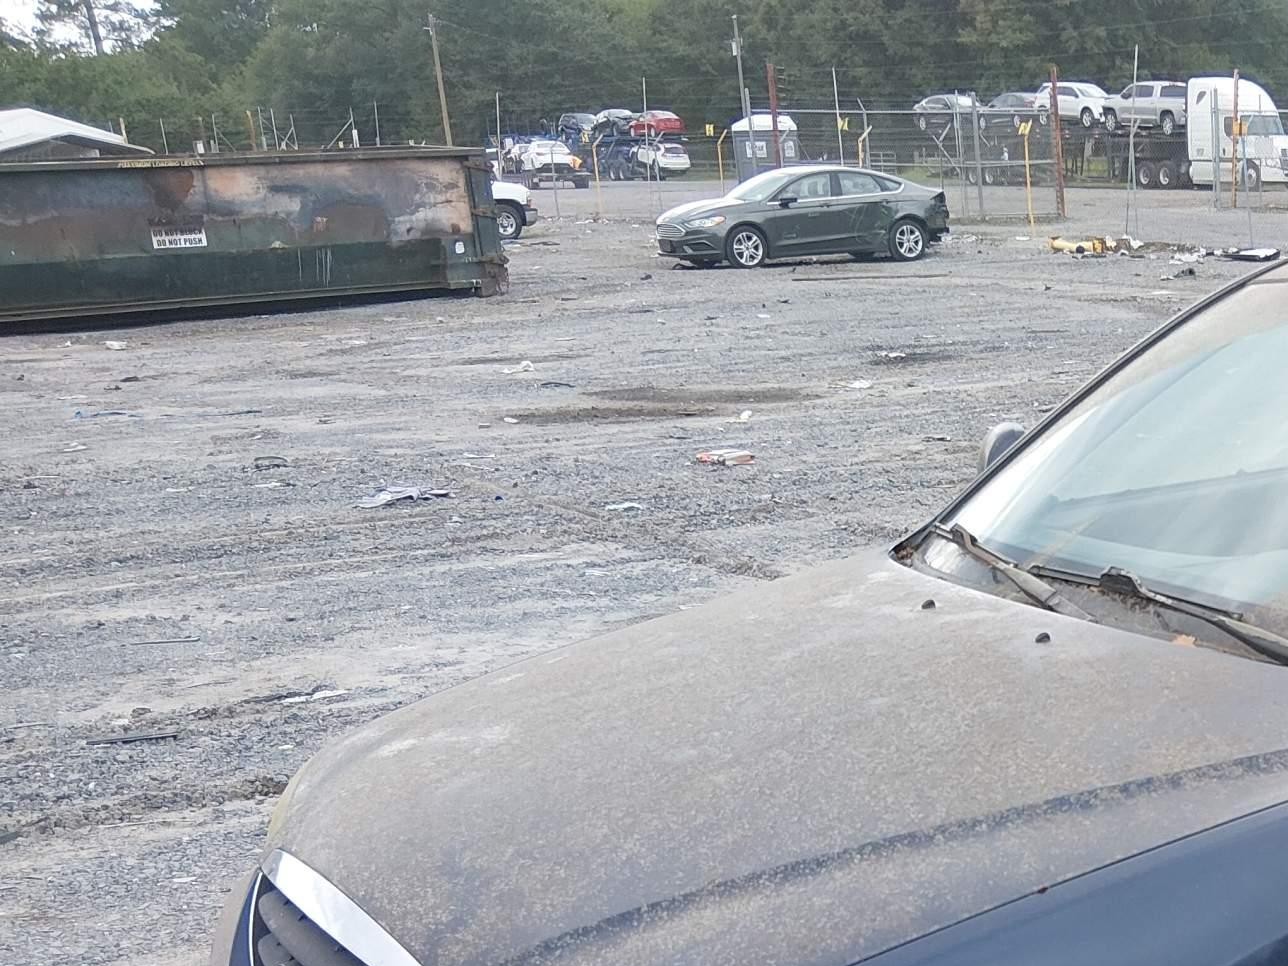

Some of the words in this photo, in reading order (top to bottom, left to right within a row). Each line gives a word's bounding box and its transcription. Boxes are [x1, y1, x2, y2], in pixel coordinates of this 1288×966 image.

[165, 228, 178, 237] NOT
[156, 239, 167, 247] DO
[168, 238, 182, 247] NOT
[183, 237, 203, 246] PUSH
